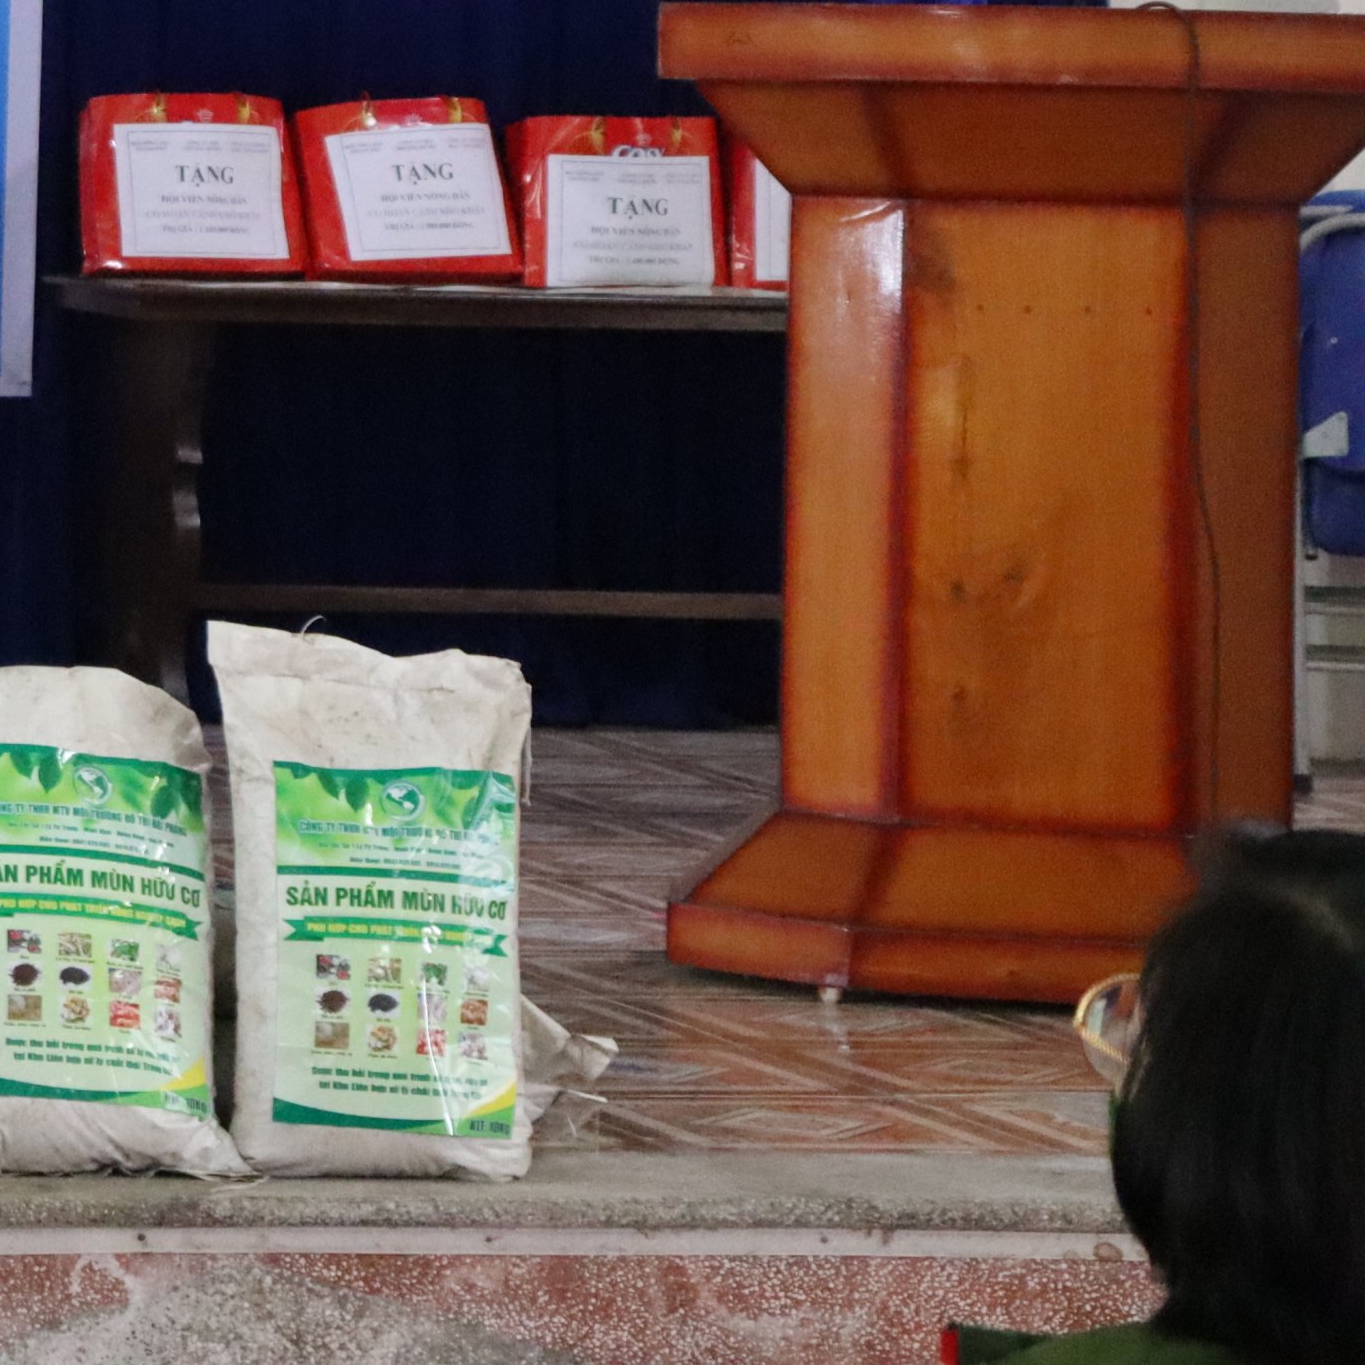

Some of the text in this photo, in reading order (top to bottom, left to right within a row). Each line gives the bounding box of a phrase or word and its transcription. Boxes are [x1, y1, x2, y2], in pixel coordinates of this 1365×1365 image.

[26, 859, 84, 887] PHẨM
[91, 868, 135, 893] MÙN
[141, 876, 175, 901] HỮU
[181, 886, 200, 907] CƠ
[286, 880, 328, 906] SẢN
[335, 880, 394, 909] PHẨM
[402, 888, 445, 914] MÙN
[488, 899, 508, 920] CƠ
